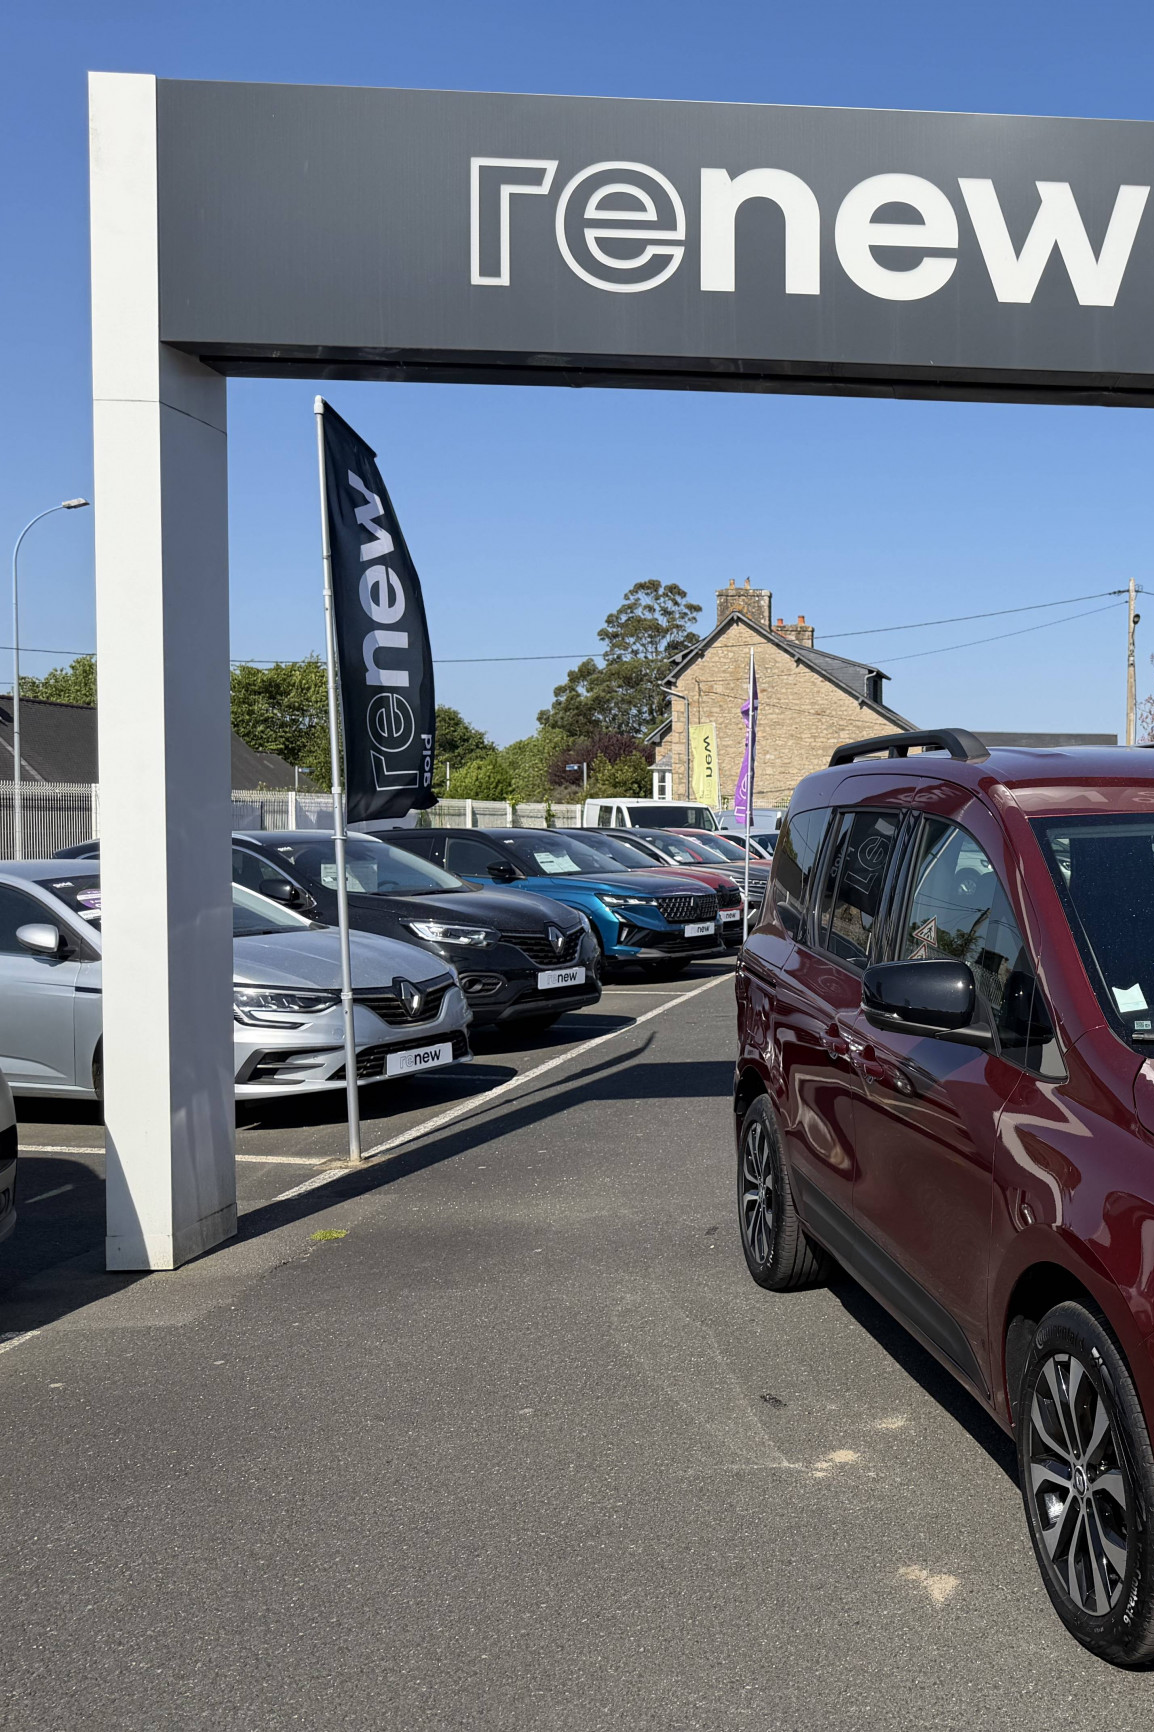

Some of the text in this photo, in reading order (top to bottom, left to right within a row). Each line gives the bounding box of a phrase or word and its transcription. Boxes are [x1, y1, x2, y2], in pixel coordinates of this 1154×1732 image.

[469, 156, 1151, 308] renew
[347, 469, 420, 792] renew
[420, 733, 433, 788] gold
[400, 1049, 441, 1069] renew
